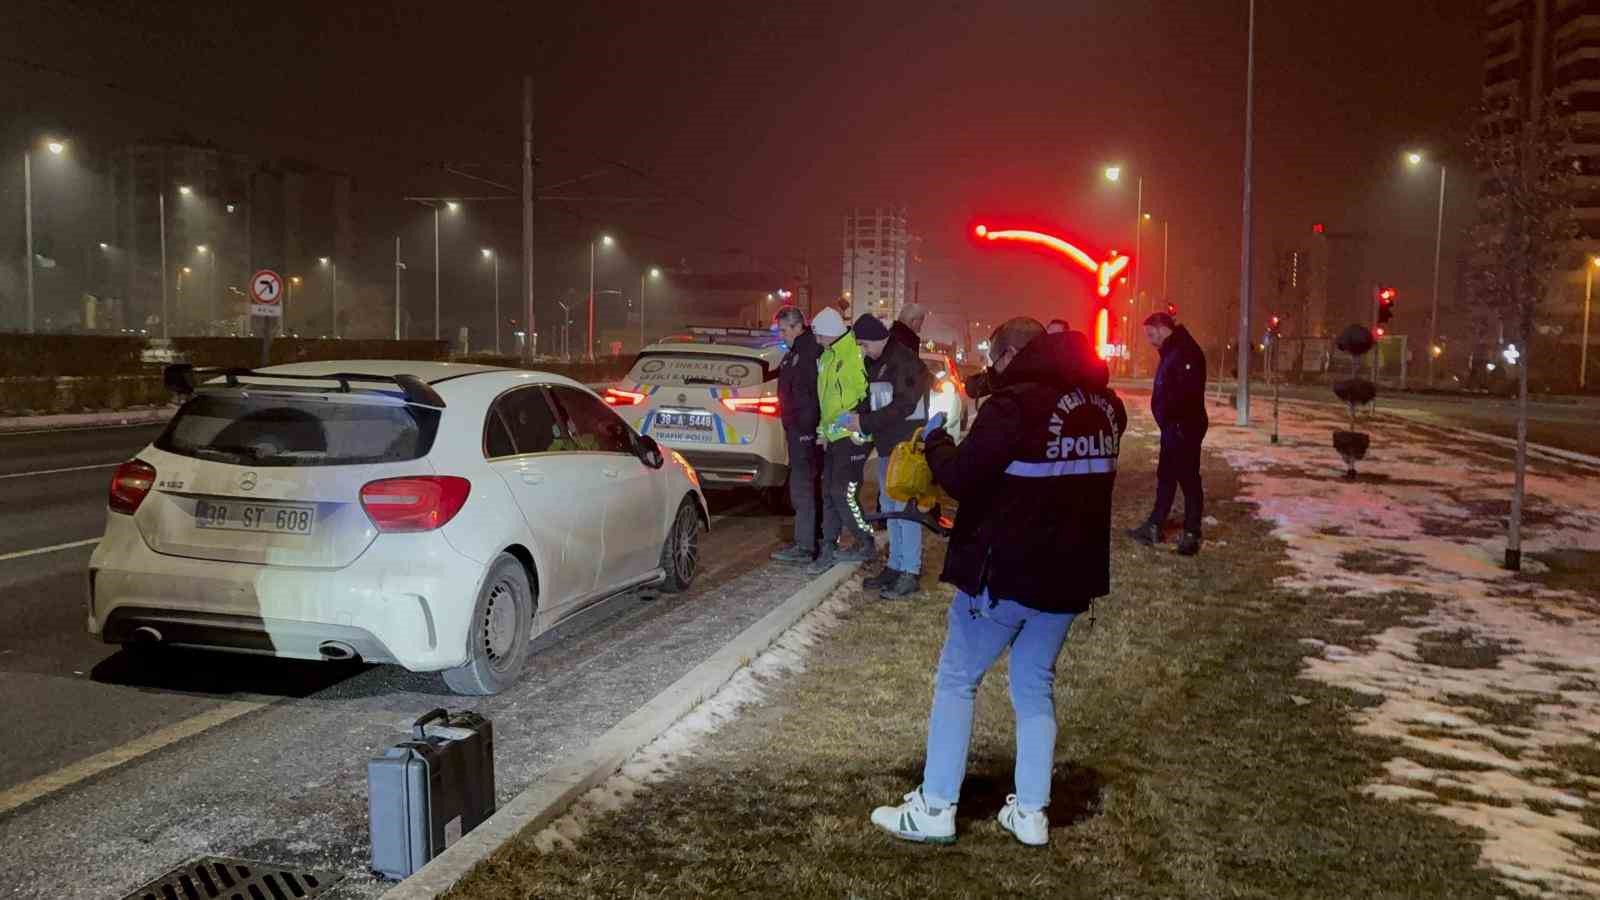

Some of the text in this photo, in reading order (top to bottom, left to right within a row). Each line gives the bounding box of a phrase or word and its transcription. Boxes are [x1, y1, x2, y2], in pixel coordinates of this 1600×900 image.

[660, 413, 671, 425] 38
[1061, 429, 1113, 459] POLİS
[206, 505, 310, 531] 38 ST 608
